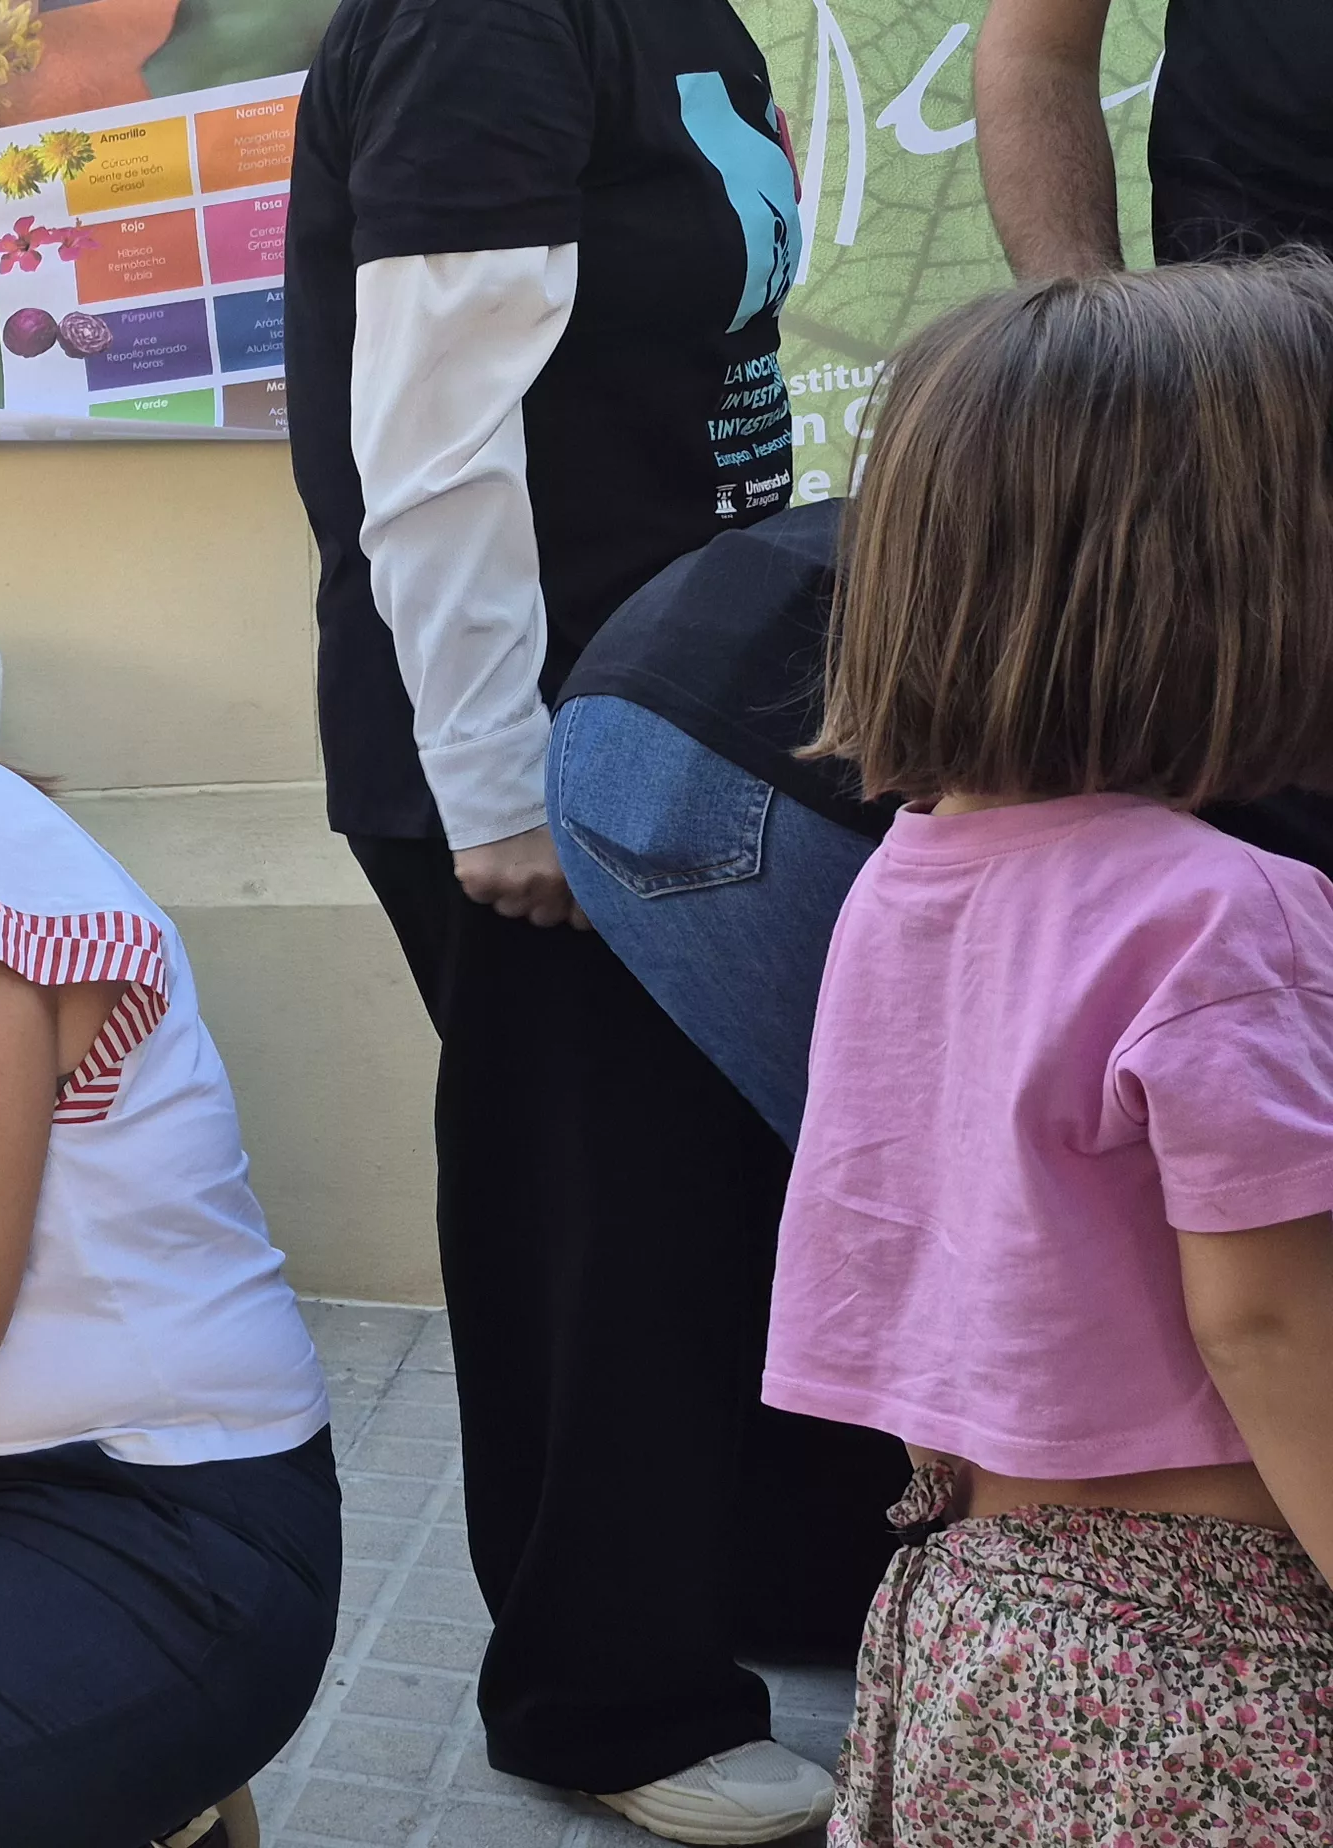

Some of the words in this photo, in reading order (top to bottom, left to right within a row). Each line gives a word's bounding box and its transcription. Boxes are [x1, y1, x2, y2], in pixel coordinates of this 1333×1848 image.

[236, 102, 284, 119] Naranja
[100, 128, 146, 144] Amarillo
[234, 128, 291, 146] Margaritas
[240, 143, 286, 157] Pimiento
[101, 155, 149, 170] Cúrcuma
[89, 171, 121, 184] Diente
[124, 169, 138, 178] de
[140, 163, 164, 176] león
[110, 180, 145, 193] Girasol
[254, 200, 283, 212] Rosa
[120, 220, 145, 233] Rojo
[117, 246, 153, 258] Hibisco
[108, 256, 166, 272] Remolacha
[124, 271, 153, 282] Rubia
[121, 310, 164, 324] Púrpura
[133, 336, 157, 347] Arce
[106, 350, 144, 363] Repollo
[146, 343, 187, 357] morado
[133, 359, 164, 371] Moras
[724, 363, 743, 385] LA
[134, 398, 168, 411] Verde
[745, 469, 791, 495] Universidad
[745, 492, 779, 509] Zaragoza
